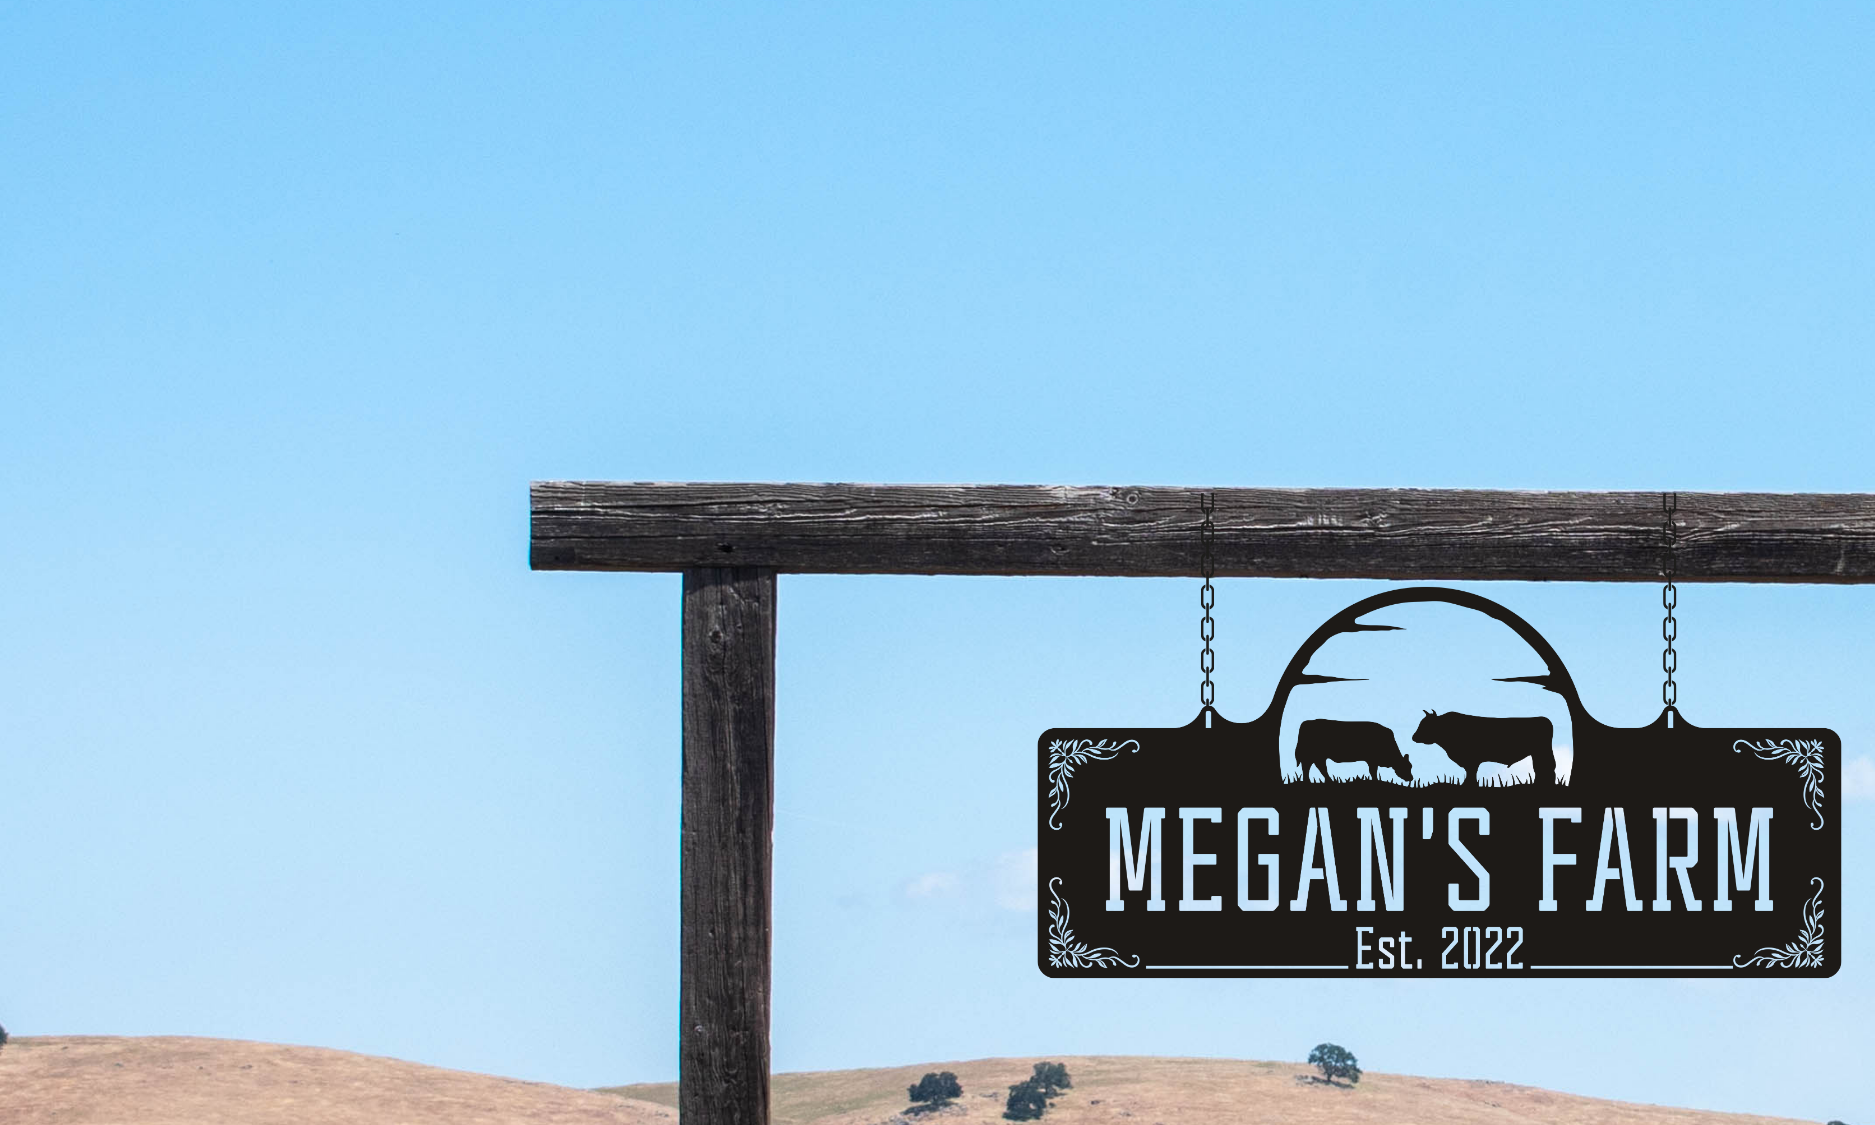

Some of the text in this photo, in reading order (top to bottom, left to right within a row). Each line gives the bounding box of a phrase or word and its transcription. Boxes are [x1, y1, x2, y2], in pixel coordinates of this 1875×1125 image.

[1105, 807, 1774, 912] MEGAN'S FARM
[1355, 926, 1524, 970] Est. 2022
